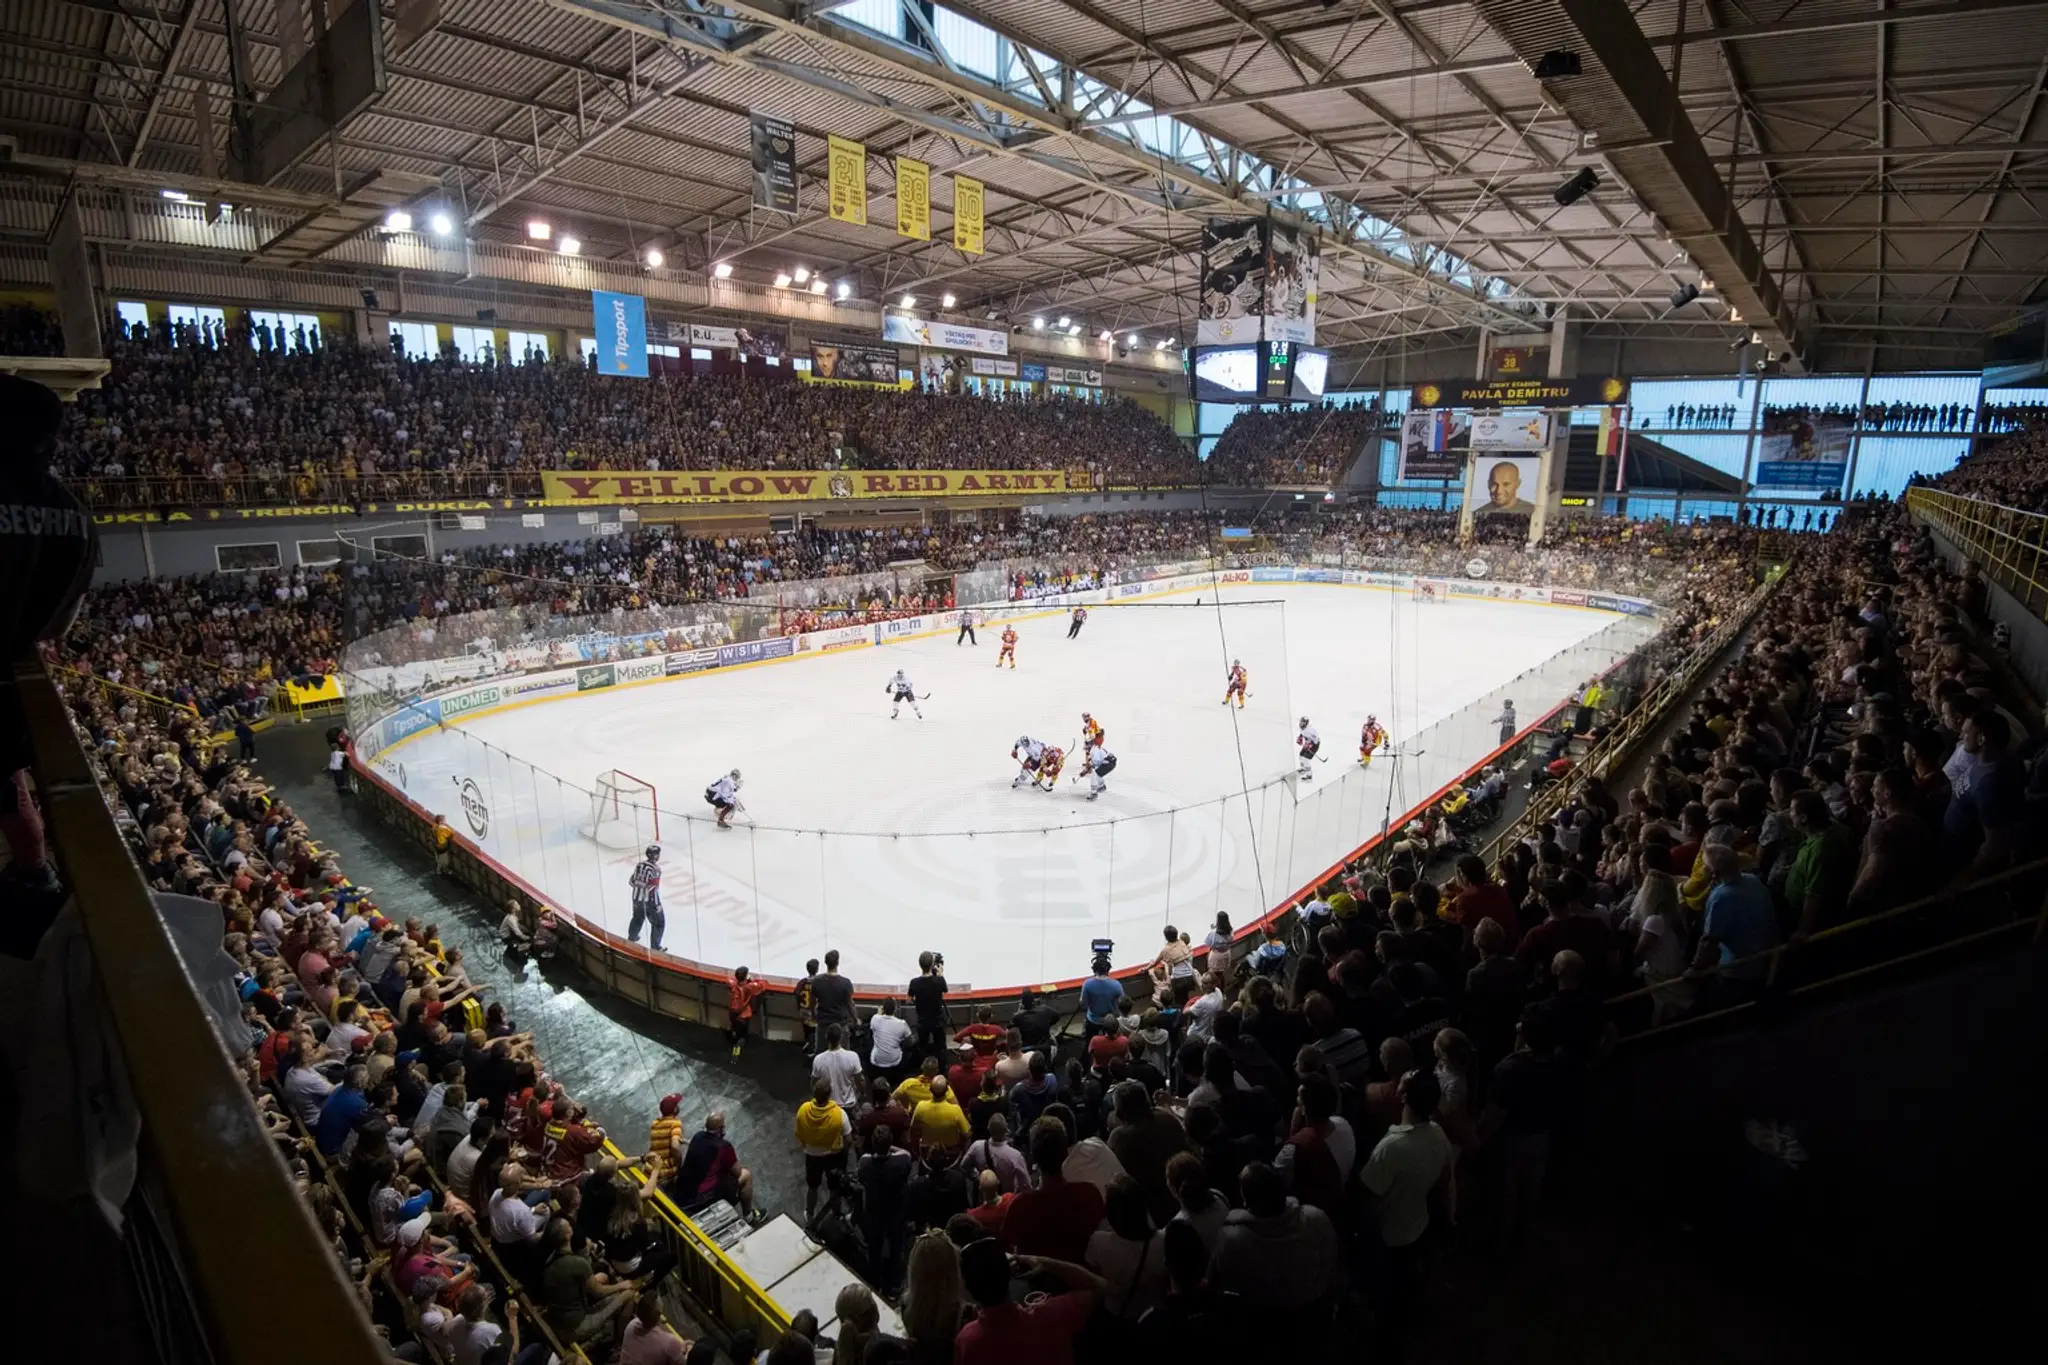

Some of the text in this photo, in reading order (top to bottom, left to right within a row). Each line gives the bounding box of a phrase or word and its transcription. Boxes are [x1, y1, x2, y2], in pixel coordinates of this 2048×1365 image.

[766, 126, 794, 140] WALTER
[835, 155, 860, 188] 21
[901, 174, 927, 206] 38
[959, 191, 980, 221] 10
[612, 299, 630, 357] Tipsport
[1462, 387, 1570, 400] PAVLA DEMITRU
[556, 474, 1060, 499] YELLOW RED ARMY
[93, 511, 193, 525] UKLA
[396, 501, 492, 512] DUKLA
[1561, 498, 1586, 506] SHOP
[617, 663, 664, 681] MARPEX
[442, 689, 499, 715] UNOMED
